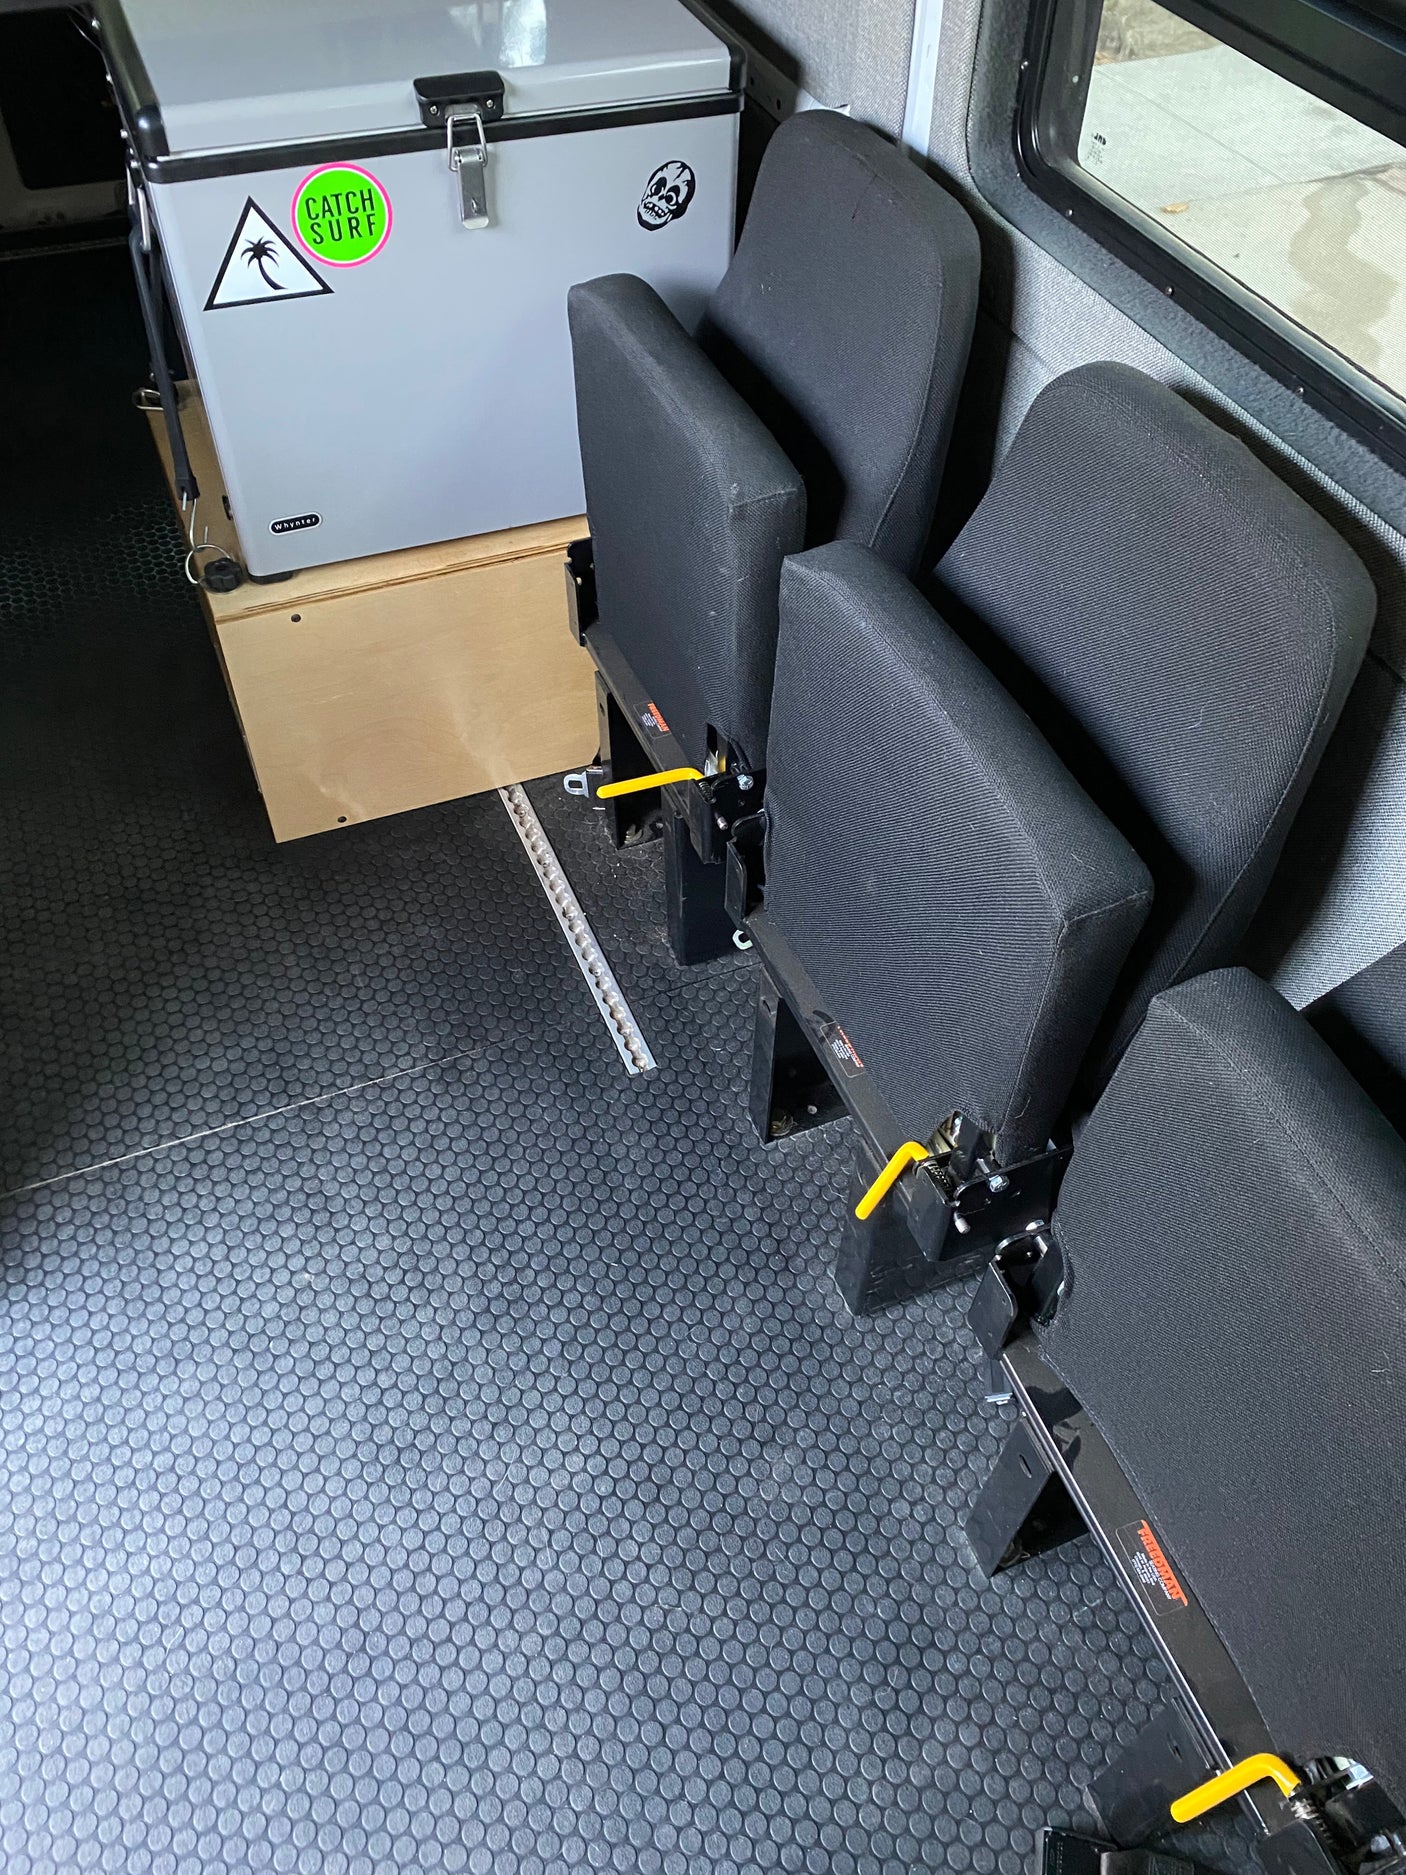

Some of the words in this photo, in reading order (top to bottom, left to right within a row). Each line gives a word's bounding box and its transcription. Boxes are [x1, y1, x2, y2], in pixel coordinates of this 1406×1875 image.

[305, 188, 375, 221] CATCH
[310, 213, 376, 245] SURF
[275, 518, 315, 530] Whynter
[1137, 1522, 1183, 1600] FREEDMAN
